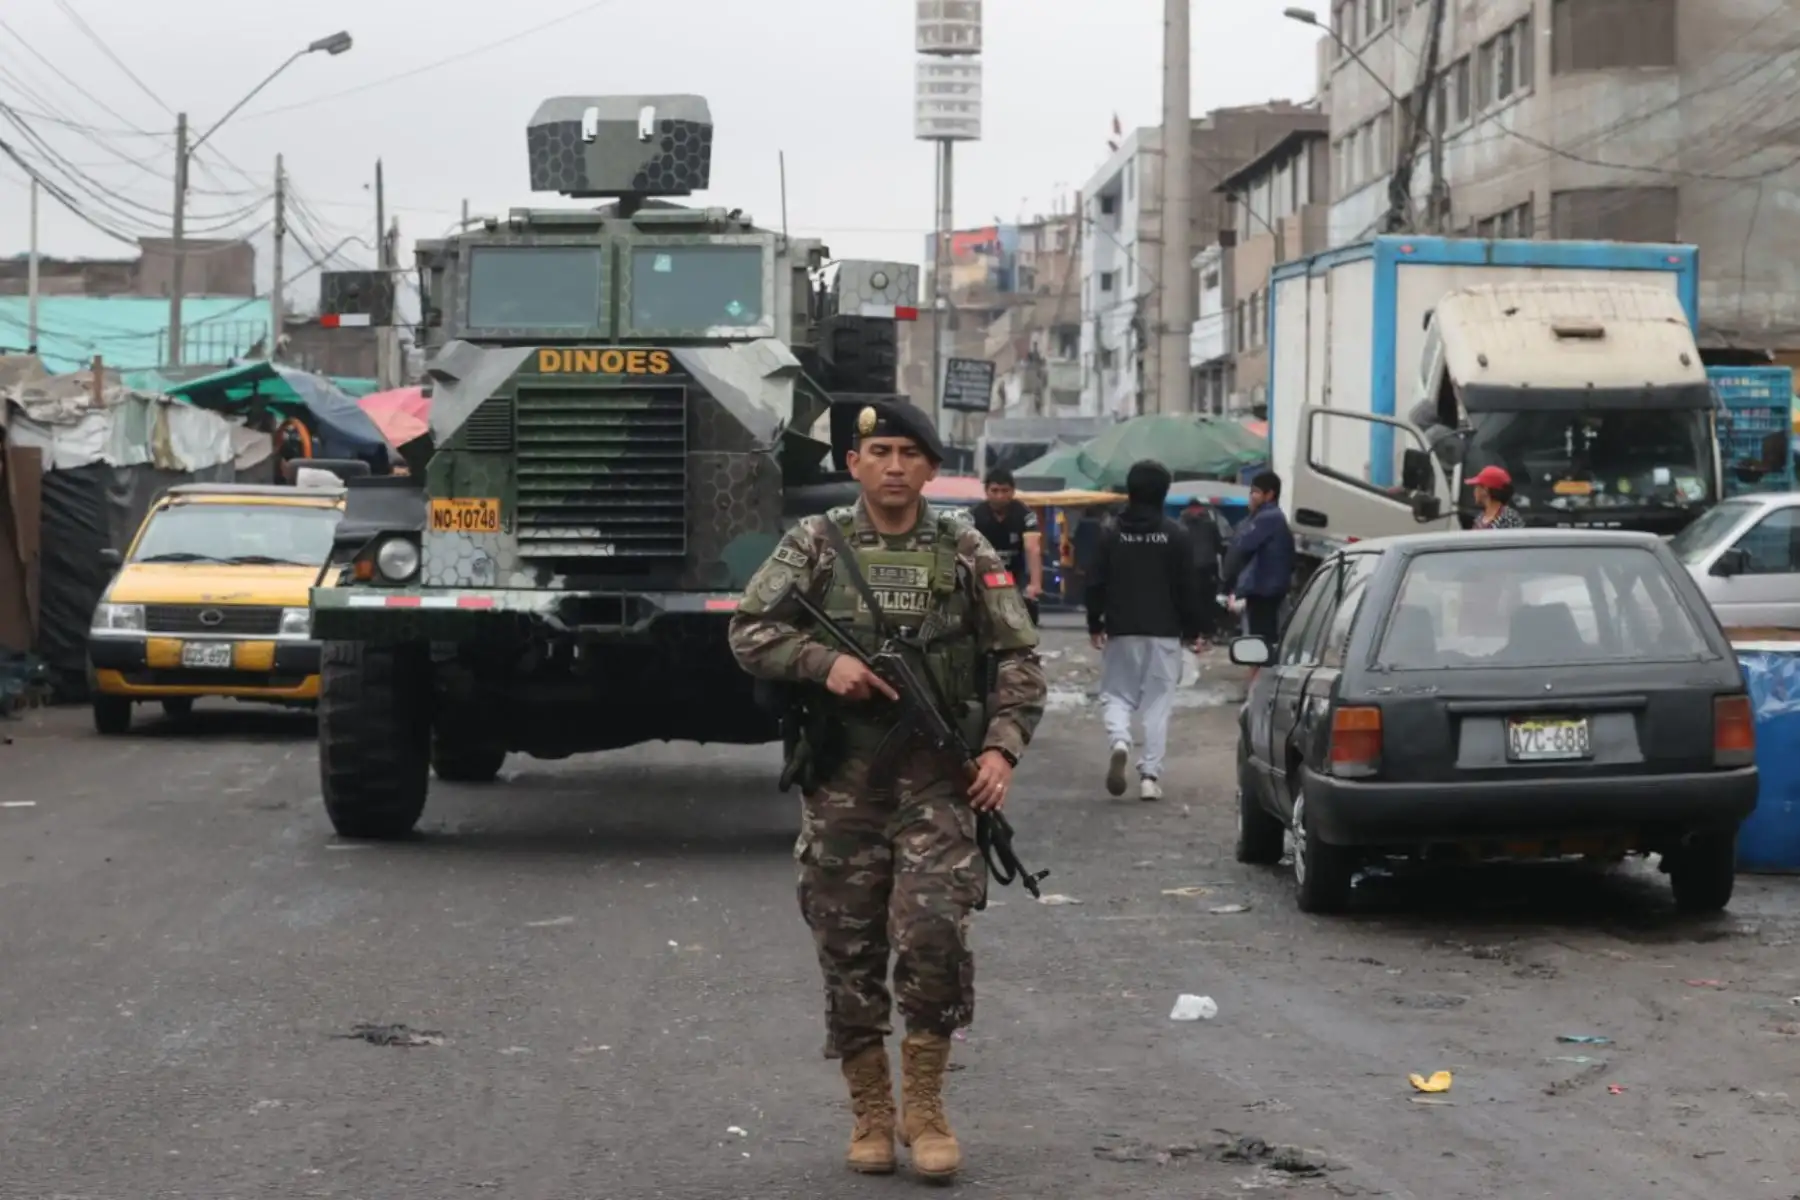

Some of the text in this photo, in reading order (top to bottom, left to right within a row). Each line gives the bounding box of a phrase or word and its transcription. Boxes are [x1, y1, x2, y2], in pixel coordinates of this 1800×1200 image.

[539, 349, 670, 374] DINOES
[433, 508, 496, 529] NO-10748
[861, 590, 928, 610] OLICIA
[1511, 726, 1587, 753] A7C-688
